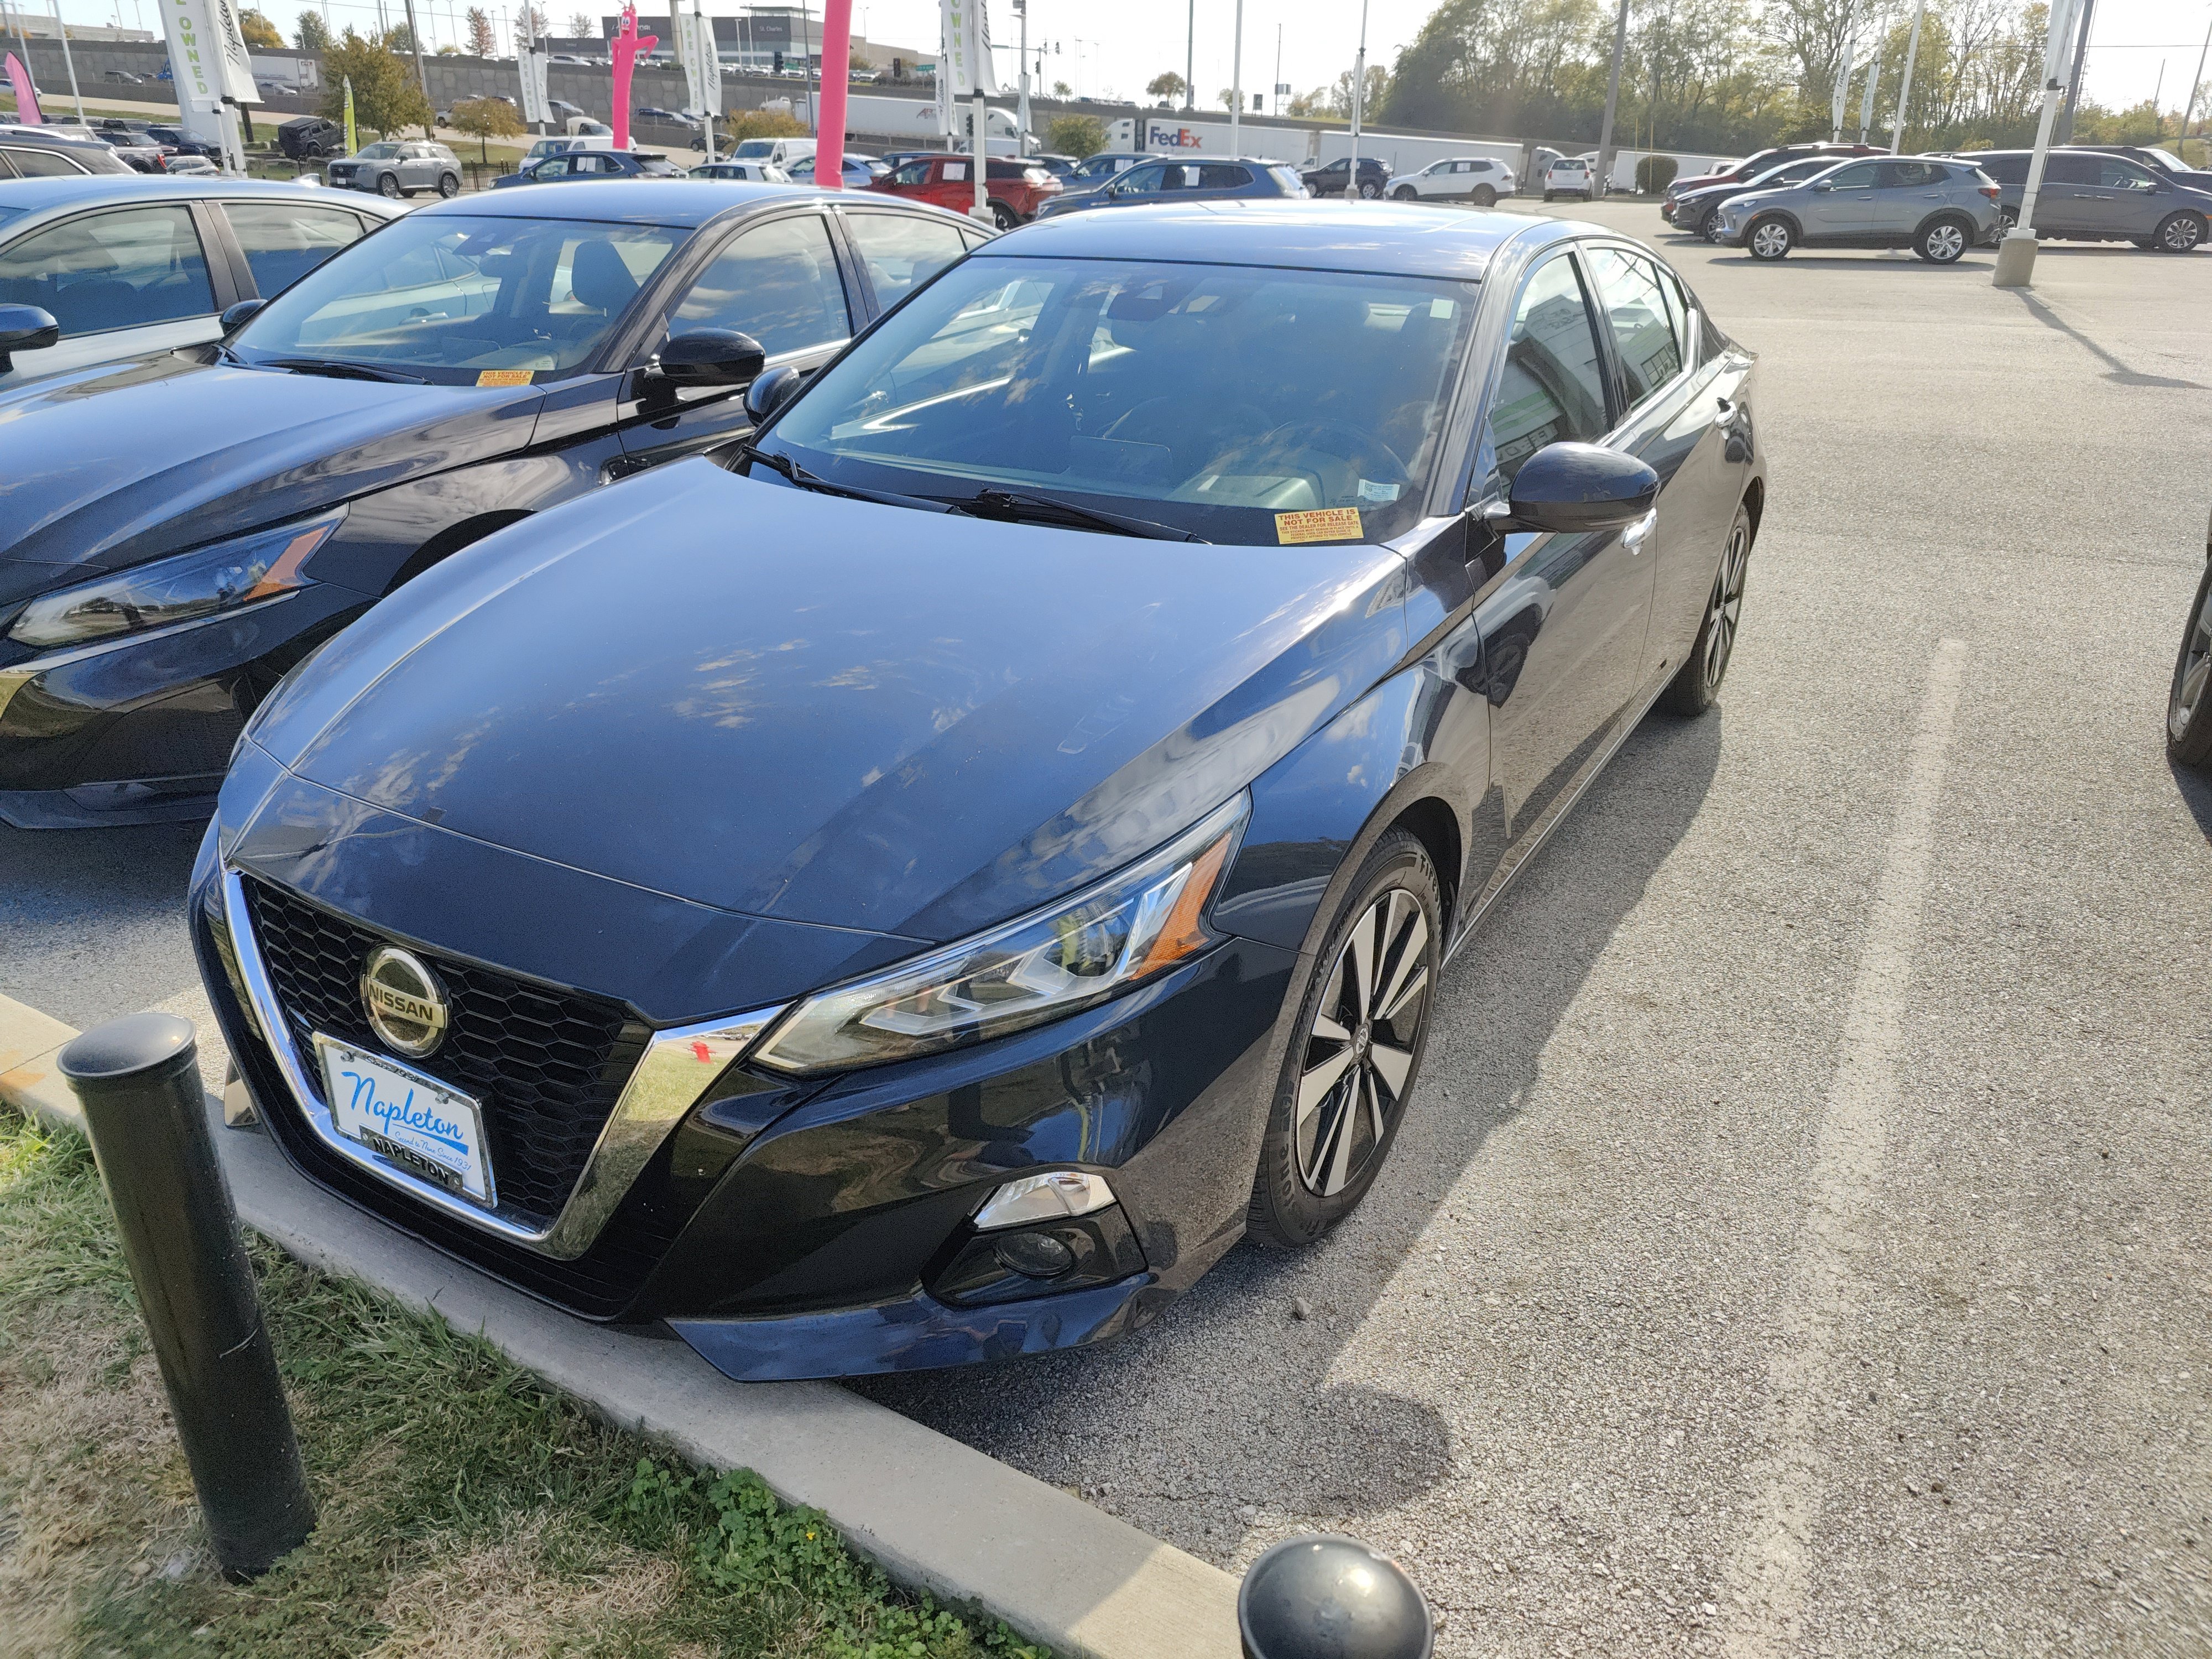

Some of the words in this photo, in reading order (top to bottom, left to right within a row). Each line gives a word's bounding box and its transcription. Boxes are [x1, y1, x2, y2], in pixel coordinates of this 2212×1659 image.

[179, 17, 208, 94] OWNED
[1150, 126, 1203, 149] FedEx
[1303, 510, 1343, 518] VEHICLE
[369, 983, 433, 1021] NISSAN
[366, 1056, 392, 1071] Since
[394, 1068, 419, 1082] 1931
[341, 1072, 464, 1140] Napleton
[373, 1138, 449, 1185] NAPLETON
[395, 1131, 415, 1145] Second
[421, 1140, 436, 1154] None
[437, 1147, 453, 1162] Since
[455, 1157, 472, 1171] 1931
